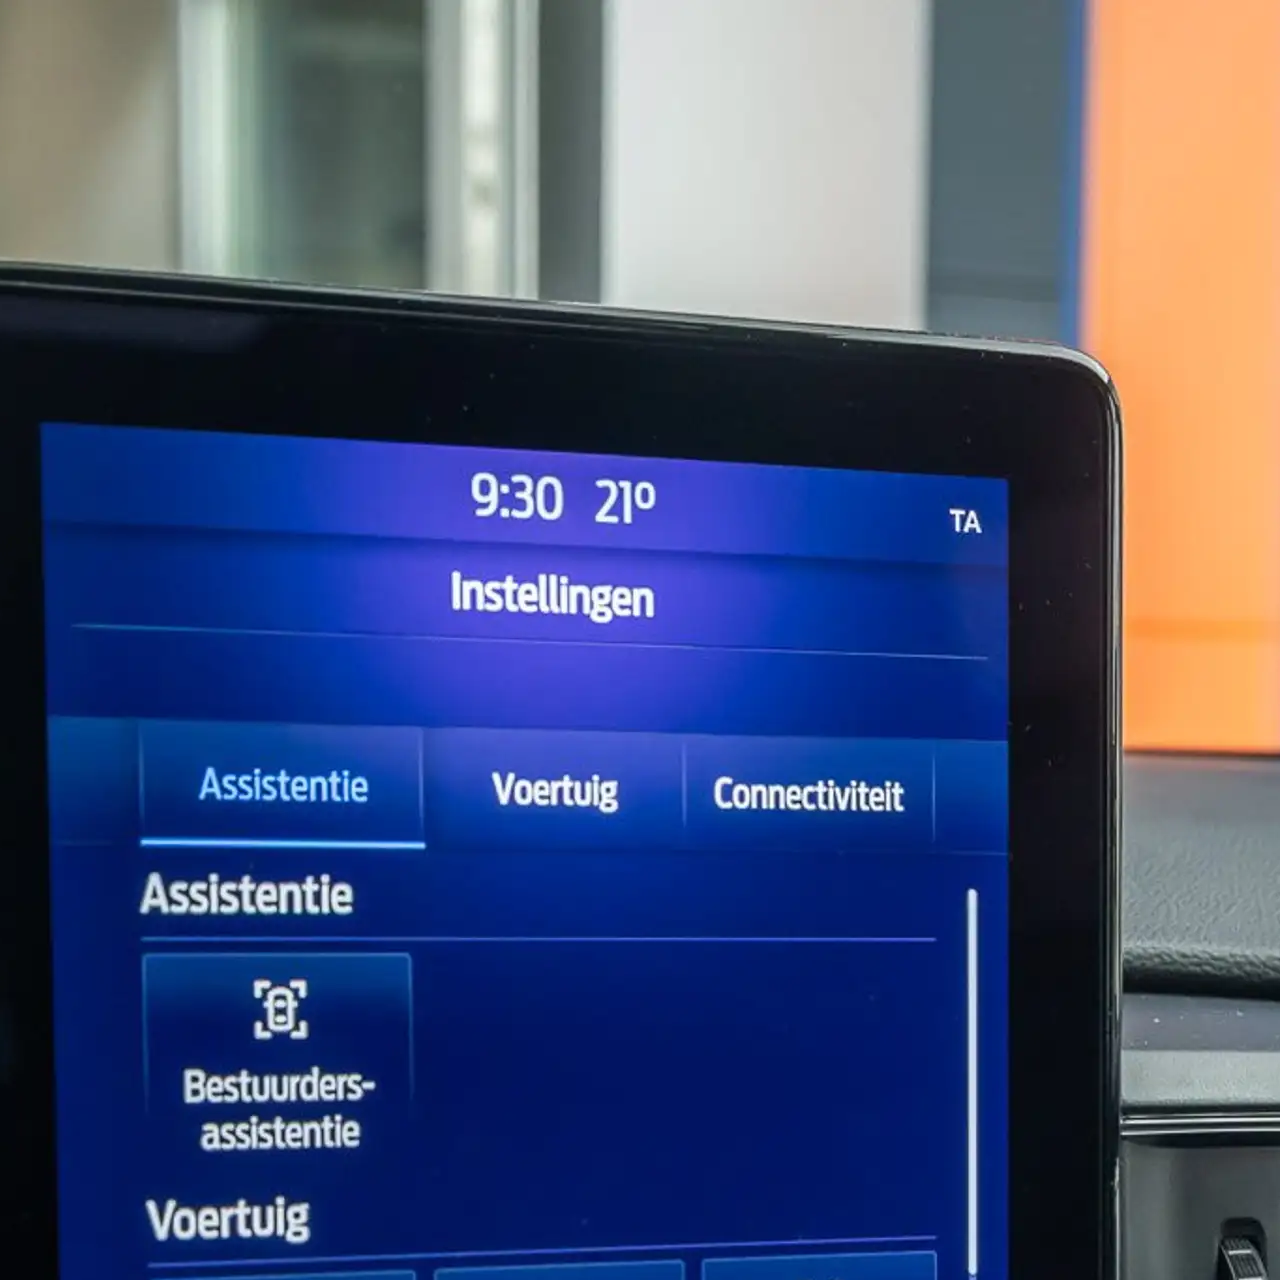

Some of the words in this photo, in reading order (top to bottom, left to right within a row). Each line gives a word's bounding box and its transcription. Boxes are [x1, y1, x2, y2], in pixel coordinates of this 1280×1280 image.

[471, 472, 564, 521] 9:30
[949, 509, 983, 534] TA
[451, 570, 655, 624] Instellingen
[199, 767, 369, 803] Assistentie
[491, 771, 619, 813] Voertuig
[714, 776, 905, 812] Connectiviteit
[139, 872, 353, 915] Assistentie
[184, 1066, 376, 1104] Bestuurders-
[200, 1114, 361, 1151] assistentie
[145, 1196, 310, 1244] Voertuig
